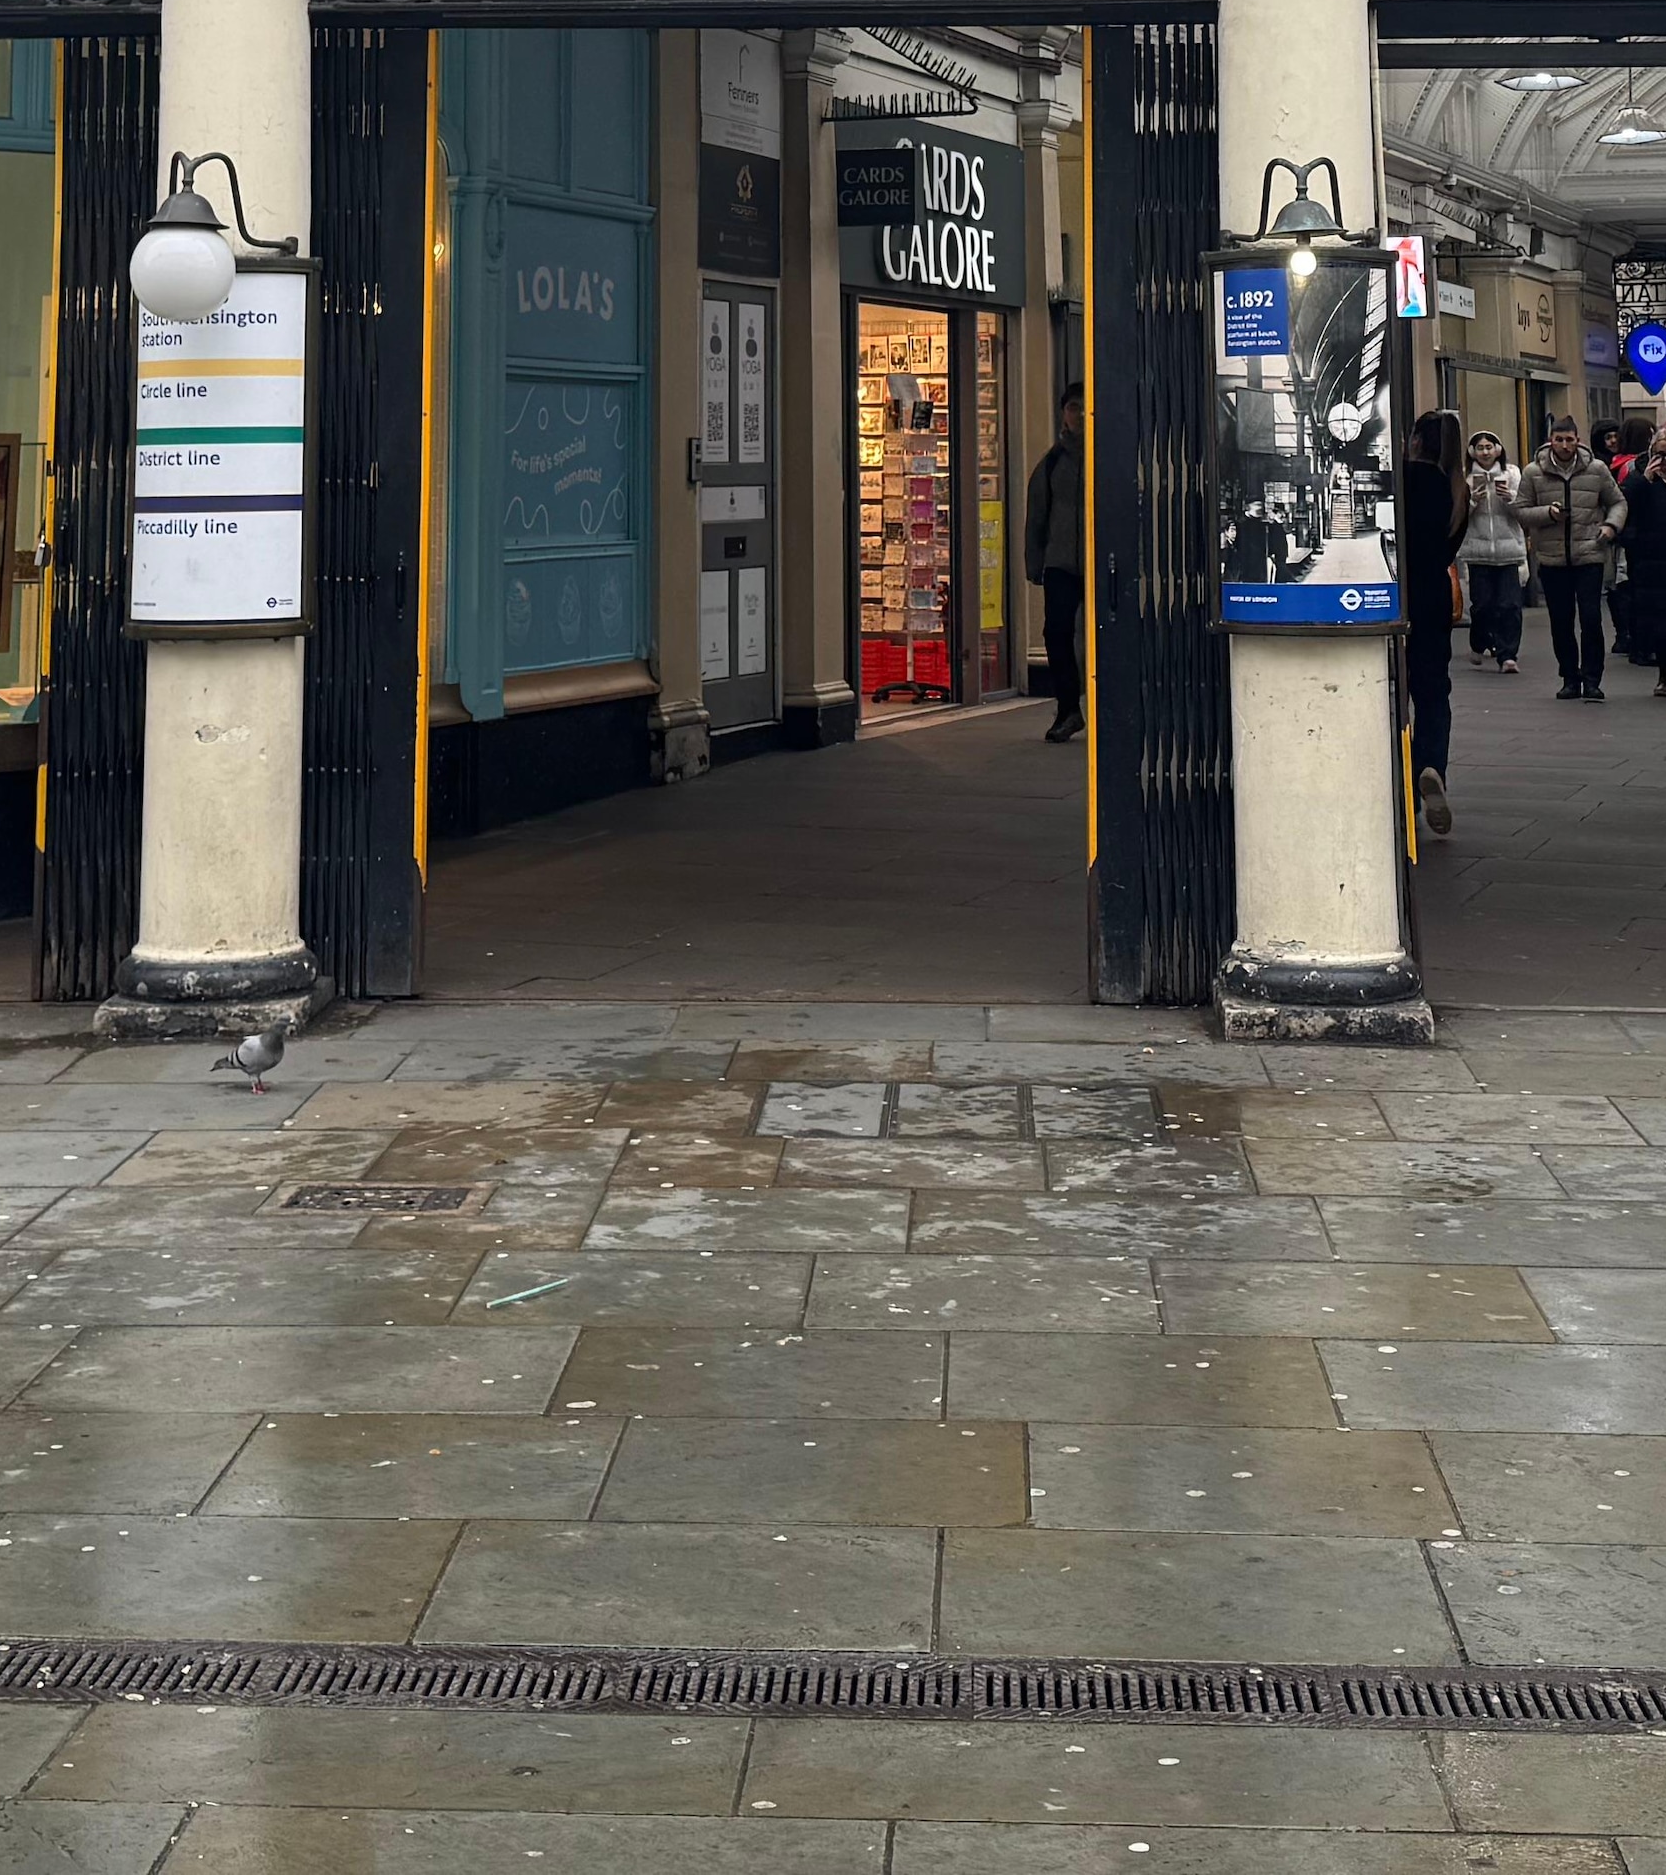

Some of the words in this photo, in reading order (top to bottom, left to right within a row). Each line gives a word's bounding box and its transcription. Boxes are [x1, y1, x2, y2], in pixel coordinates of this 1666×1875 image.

[844, 166, 905, 184] CARDS
[840, 188, 910, 206] GALORE
[883, 219, 996, 293] GALORE
[517, 266, 615, 321] LOLA'S
[142, 331, 182, 347] station
[1643, 343, 1663, 356] Fix
[705, 357, 726, 372] YOGA
[741, 360, 761, 374] YOGA
[141, 383, 172, 399] Circle
[177, 382, 207, 398] line
[139, 451, 183, 467] District
[188, 450, 221, 465] line
[554, 435, 586, 468] special
[555, 468, 602, 495] moments!
[137, 519, 198, 538] Piccadilly
[205, 519, 238, 534] line
